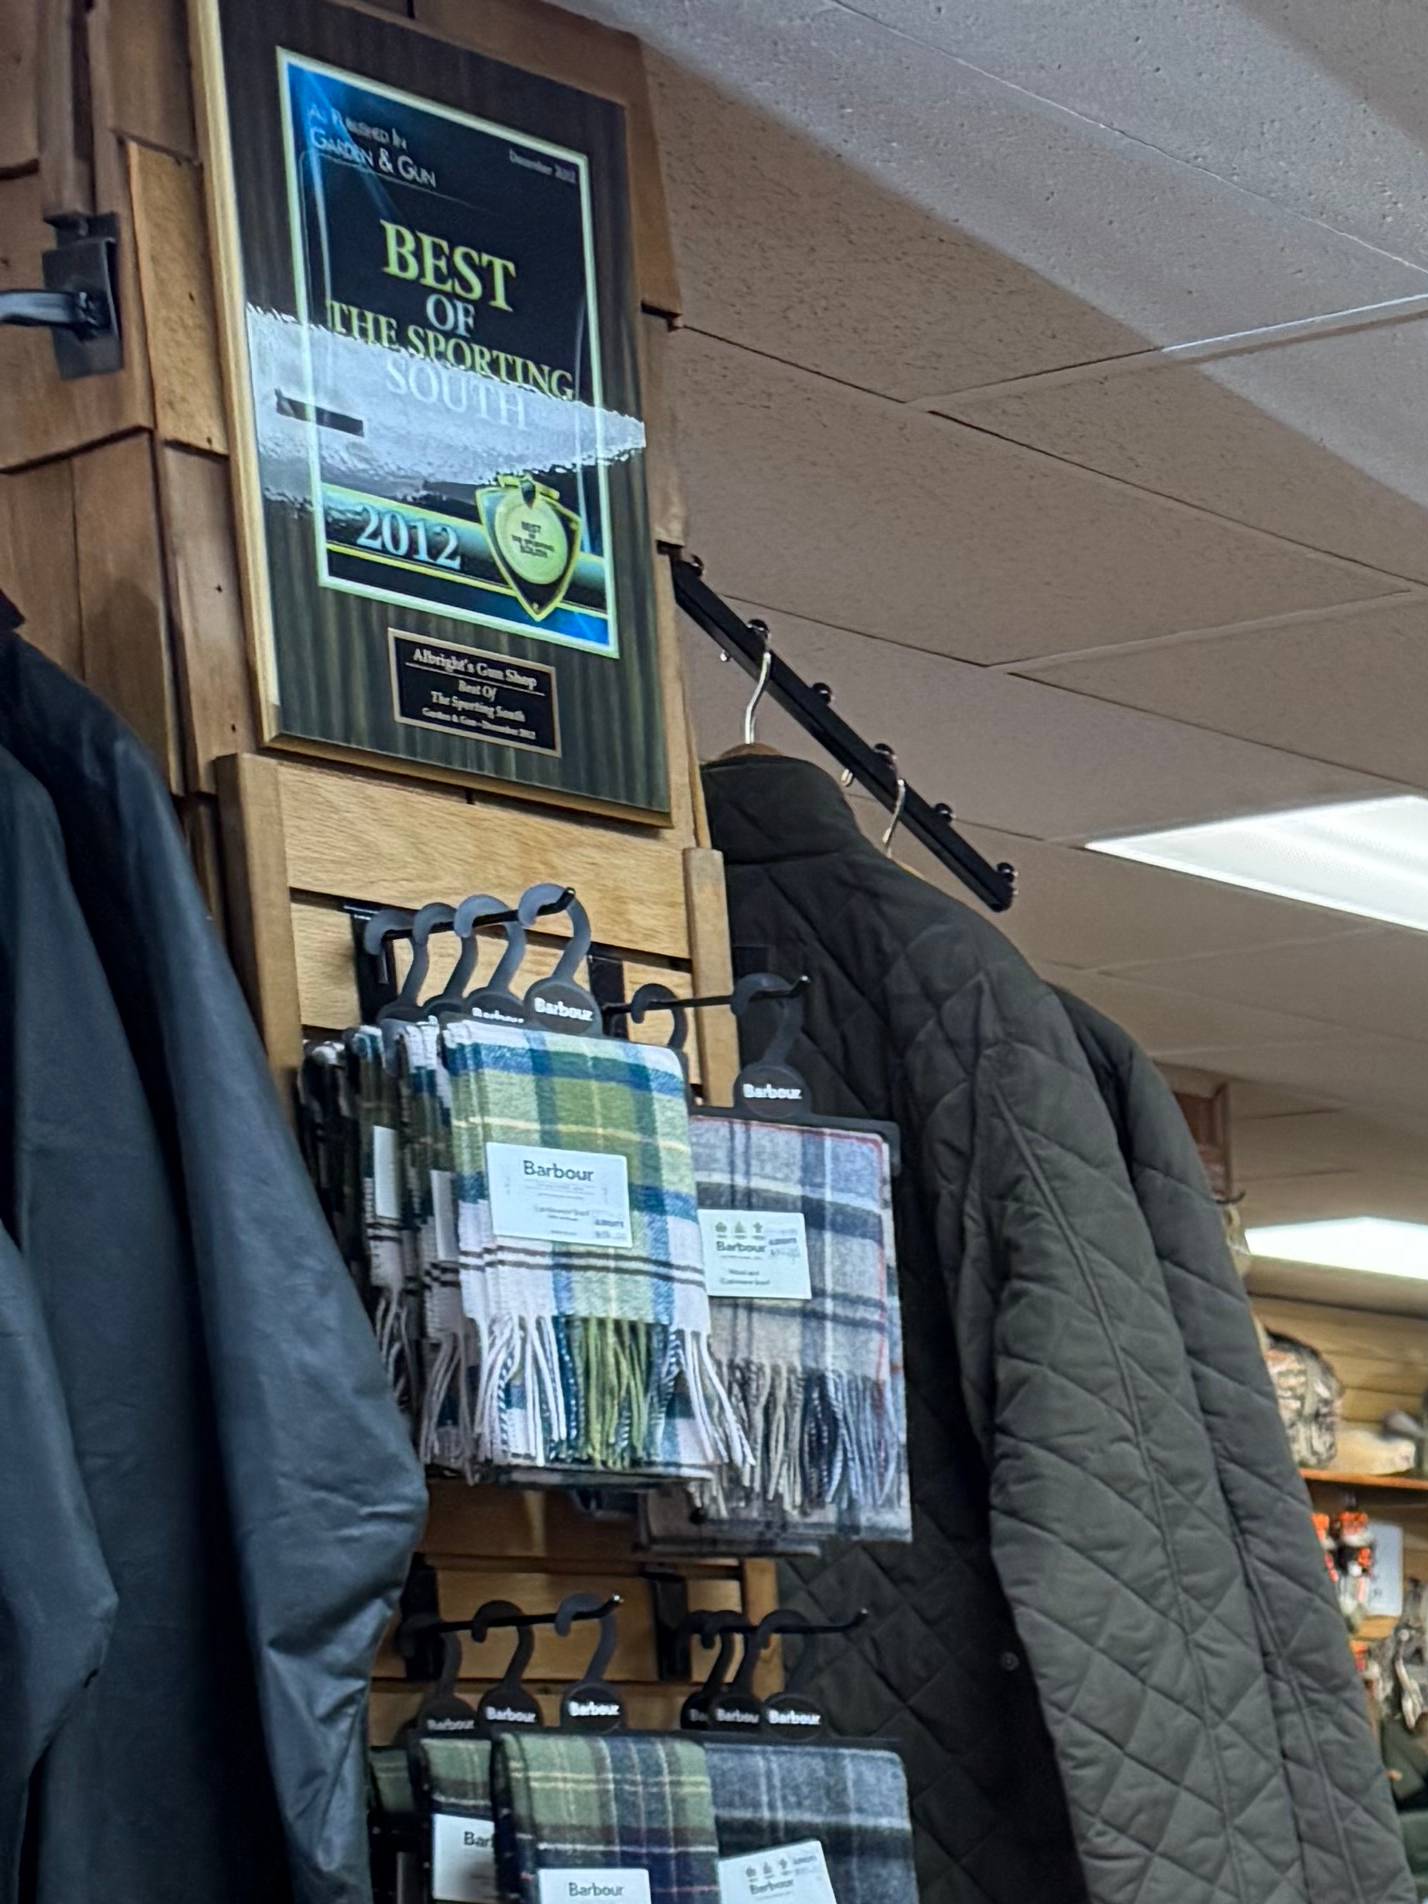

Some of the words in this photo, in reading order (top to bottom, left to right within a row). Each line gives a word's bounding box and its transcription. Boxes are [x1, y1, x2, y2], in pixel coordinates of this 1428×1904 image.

[378, 146, 394, 176] &
[380, 218, 518, 313] BEST
[425, 293, 476, 338] OF
[330, 299, 399, 349] THE
[406, 324, 576, 401] SPORTING
[387, 355, 529, 431] SOUTH
[356, 504, 462, 571] 2012
[412, 648, 475, 674] Albright's
[476, 662, 505, 681] Gun
[505, 668, 538, 691] Shop
[533, 996, 595, 1023] Barbour
[743, 1083, 803, 1101] Barbour
[522, 1159, 596, 1183] Barbour
[716, 1240, 767, 1254] Barbour
[485, 1706, 537, 1724] Barbour
[568, 1701, 620, 1717] Barbour
[716, 1708, 760, 1724] Barbou
[767, 1709, 821, 1726] Barbour
[426, 1716, 475, 1731] Barbour
[568, 1881, 625, 1898] Barbour
[749, 1877, 795, 1897] Barbour
